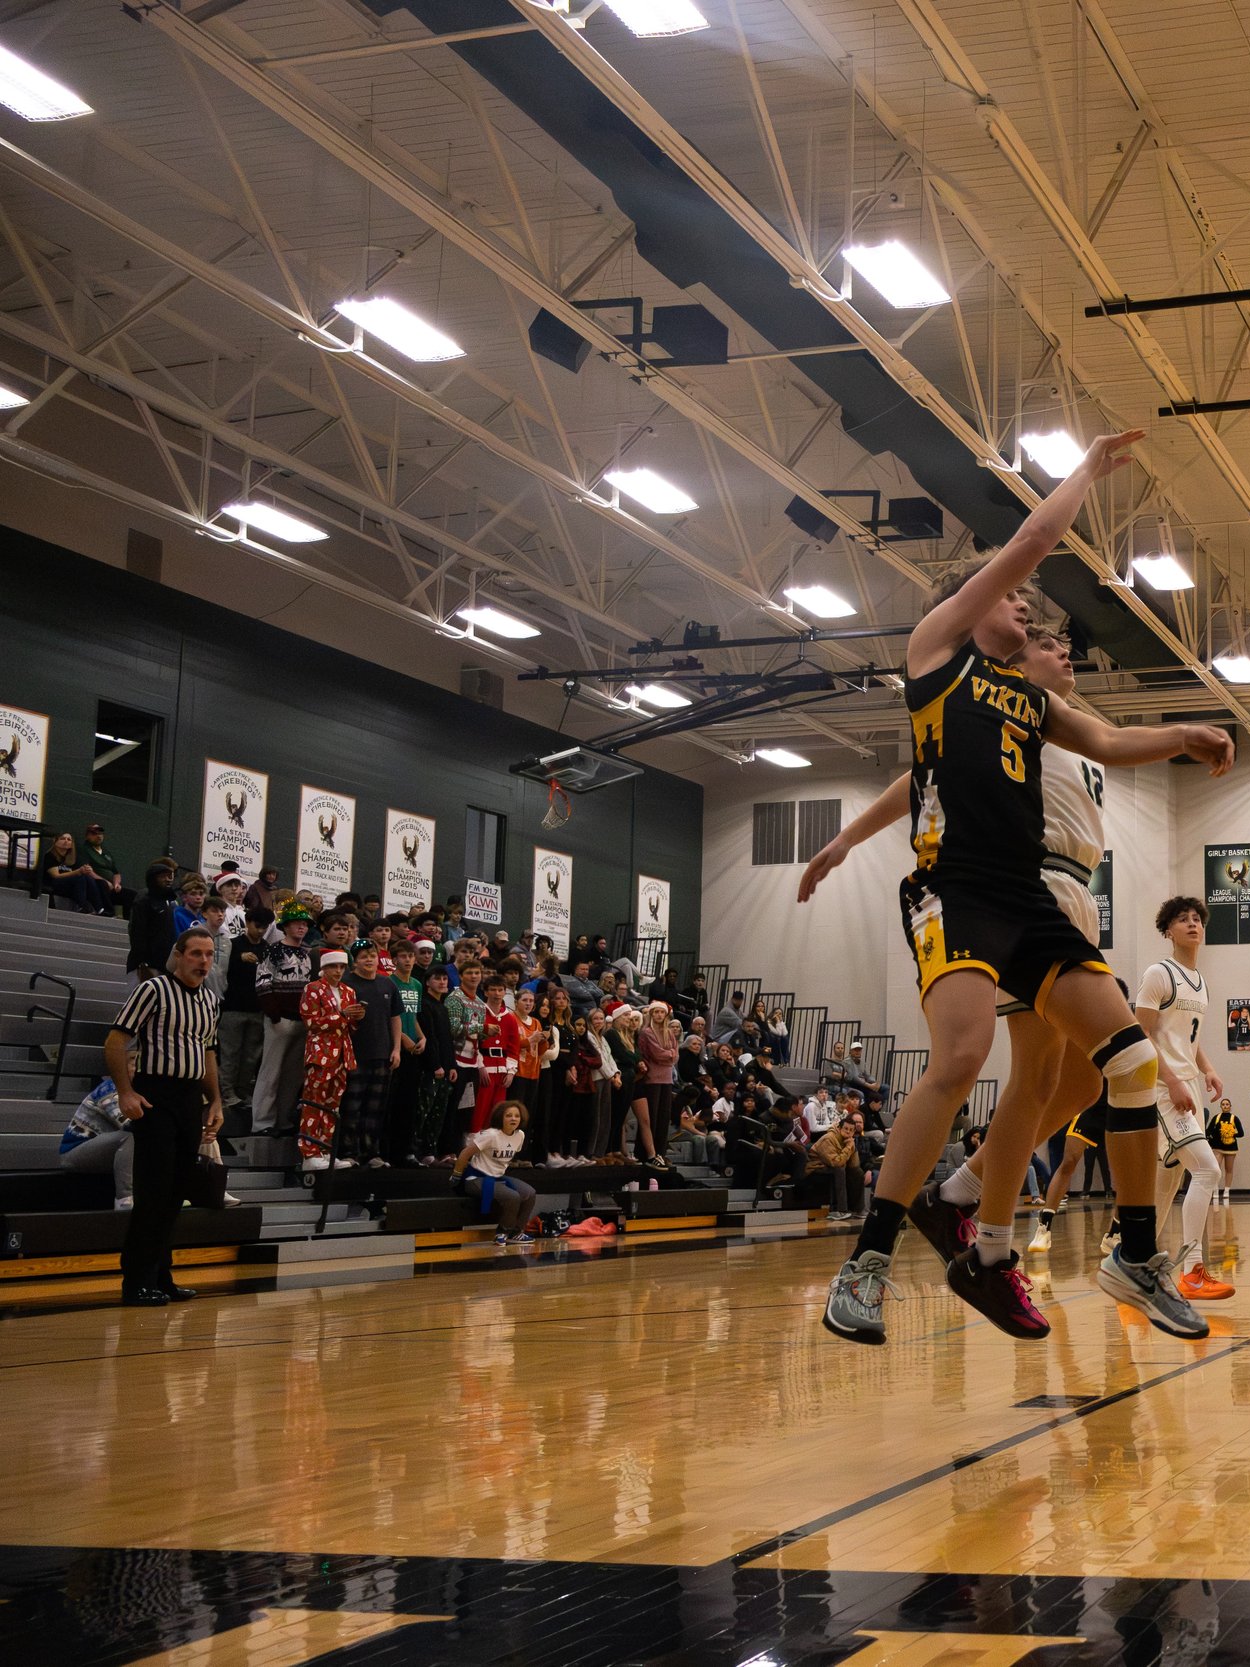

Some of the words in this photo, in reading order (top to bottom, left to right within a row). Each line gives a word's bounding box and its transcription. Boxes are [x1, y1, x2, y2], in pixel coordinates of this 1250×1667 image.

[9, 712, 26, 724] FREE
[1001, 720, 1028, 783] 5
[218, 778, 256, 798] FIREBIRDS
[20, 812, 36, 821] FIELD
[311, 802, 345, 821] FIREBIRDS
[230, 830, 250, 838] STATE
[207, 831, 260, 853] CHAMPIONS
[223, 843, 244, 853] 2014
[213, 851, 253, 864] GYMNASTICS
[322, 850, 340, 858] STATE
[302, 852, 348, 872] CHAMPIONS
[316, 862, 335, 871] 2014
[388, 872, 429, 889] CHAMPIONS
[401, 881, 417, 889] 2015
[393, 888, 423, 899] BASEBALL
[469, 884, 480, 892] FM
[469, 894, 498, 911] KLWN
[468, 910, 480, 918] AM
[536, 904, 568, 919] CHAMPIONS
[399, 990, 419, 1000] REE
